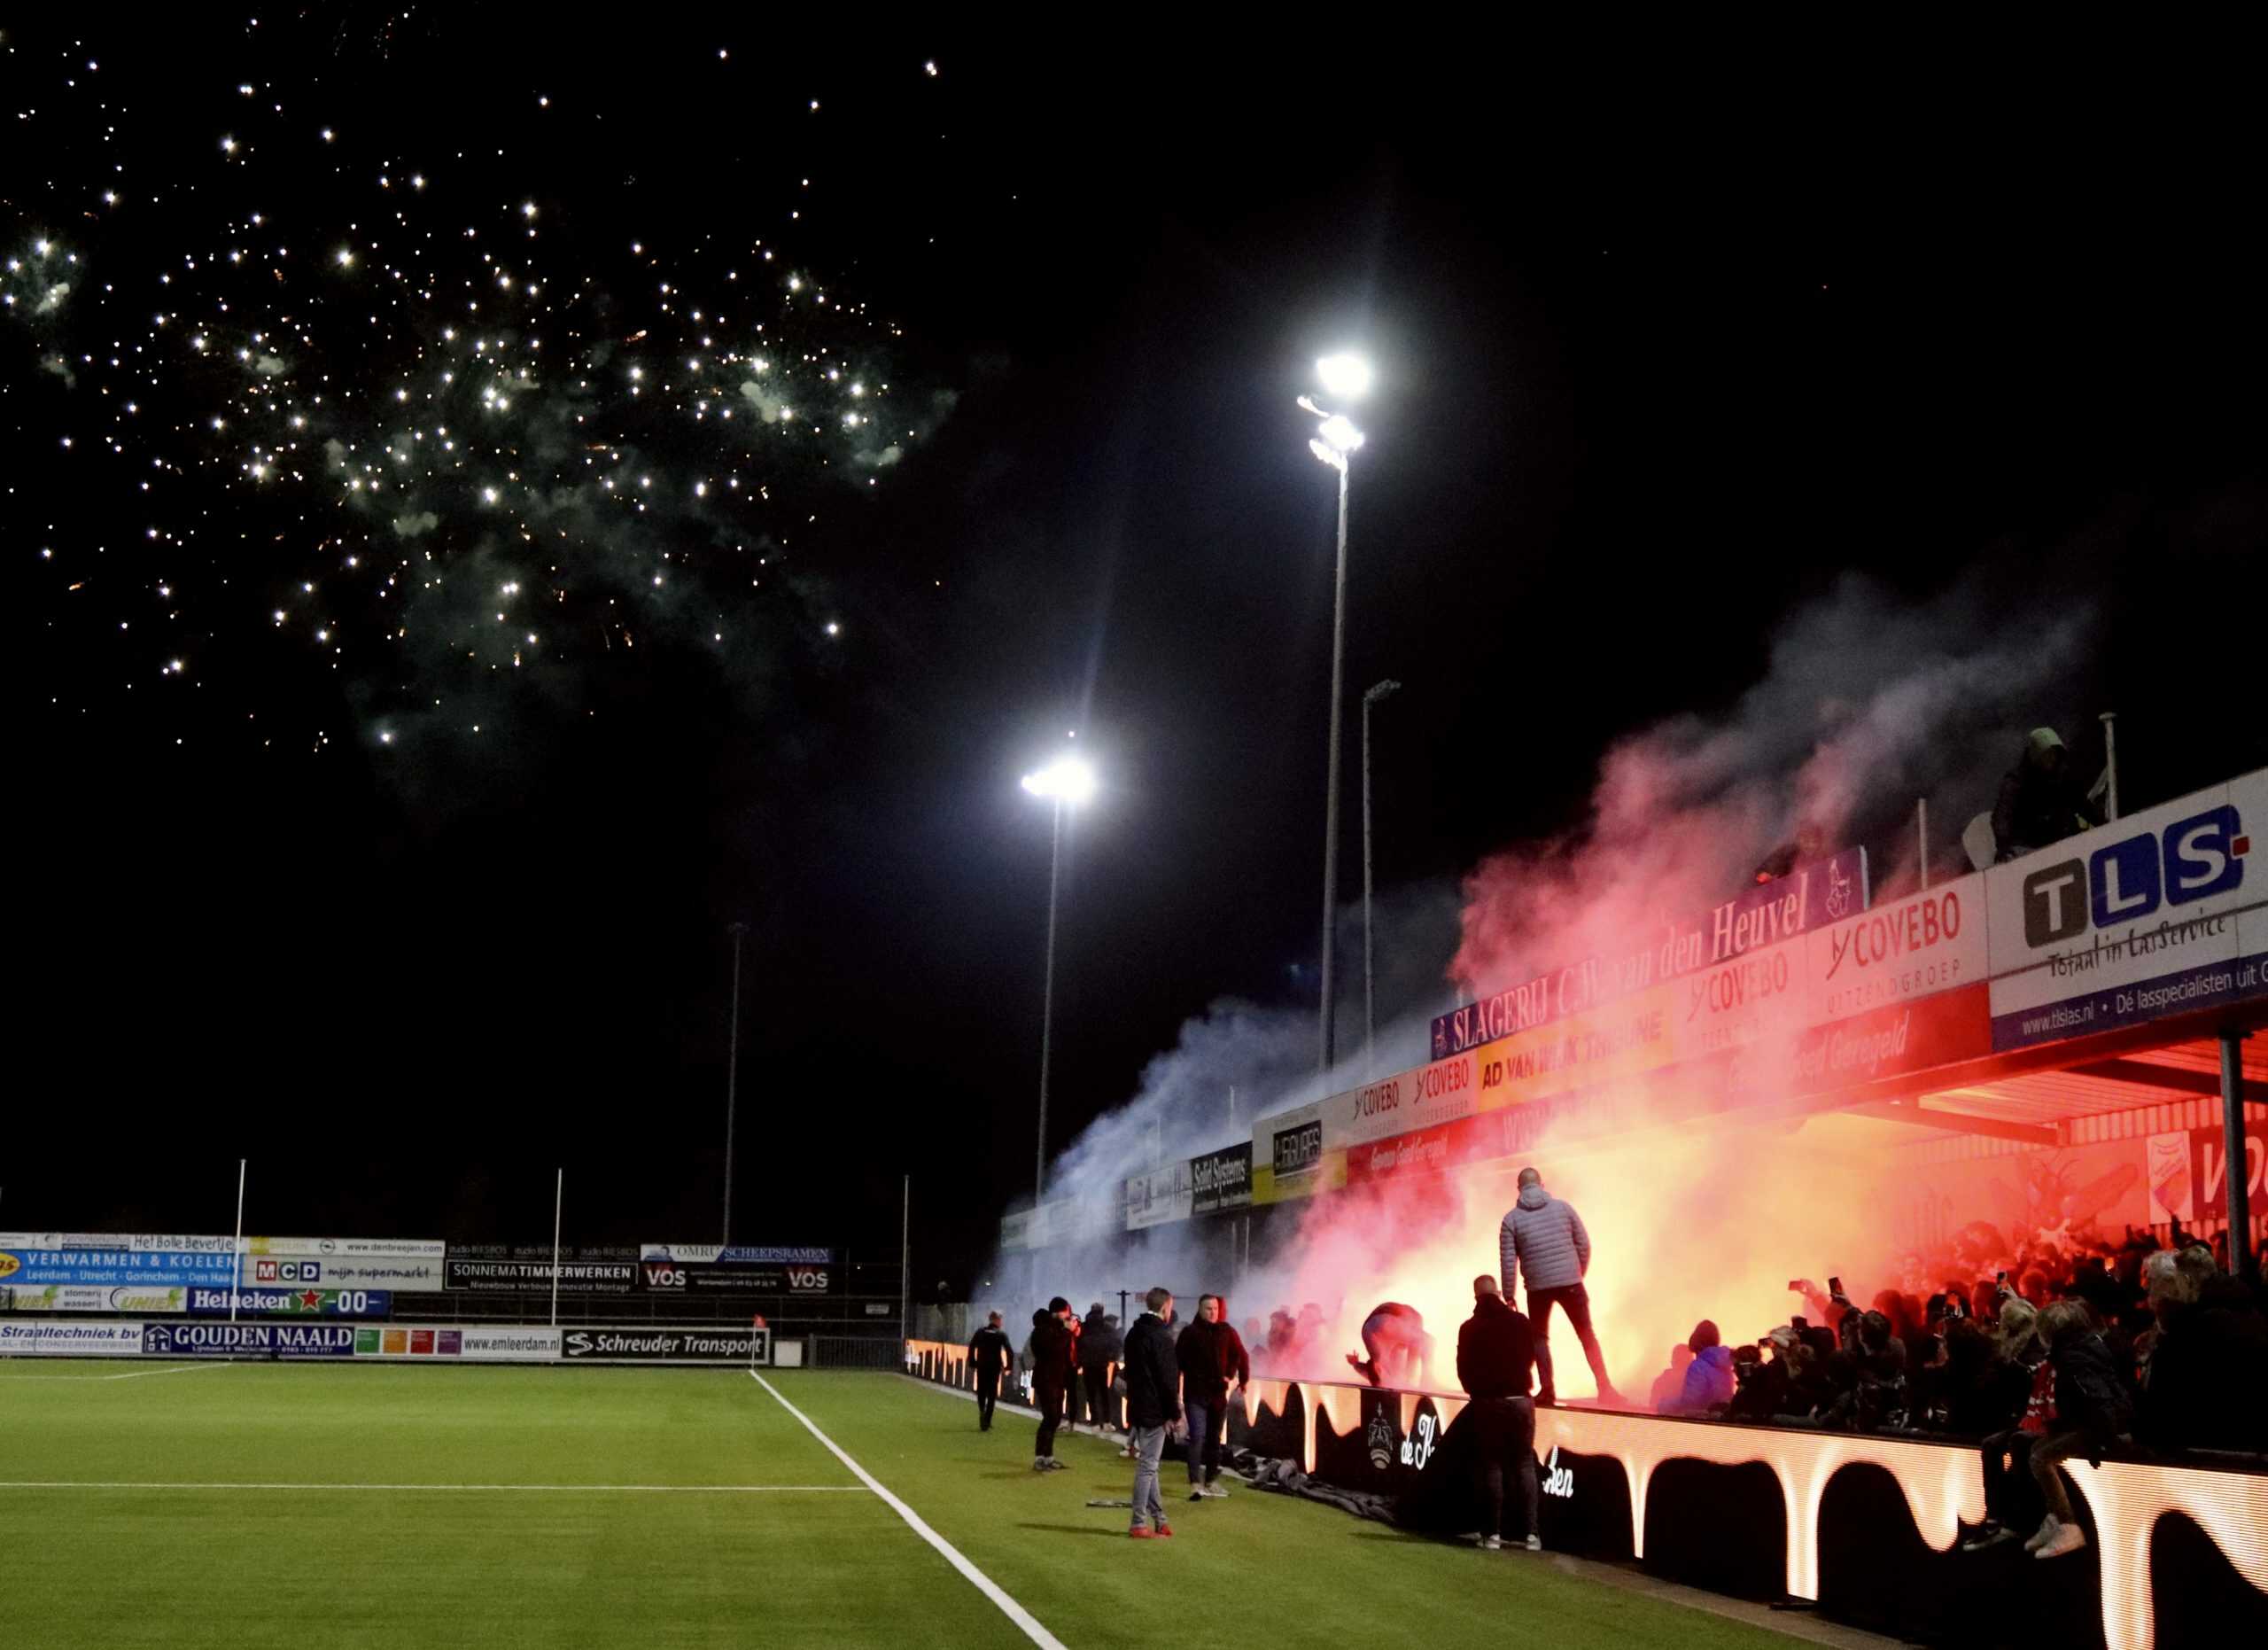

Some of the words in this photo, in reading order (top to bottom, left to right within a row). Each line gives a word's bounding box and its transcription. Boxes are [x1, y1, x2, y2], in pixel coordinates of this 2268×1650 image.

[2032, 823, 2227, 932] TLS
[1855, 891, 1961, 968] COVEBO
[1454, 977, 1550, 1051] SLAGERIJ
[1660, 925, 1701, 977] den
[1711, 872, 1808, 962] Heuvel
[1709, 951, 1789, 1013] COVEBO
[2023, 1001, 2093, 1036] www.tlslas.nl
[2117, 990, 2133, 1015] Dé
[2137, 970, 2233, 1013] lasspecialisten
[2237, 965, 2256, 986] uit
[1426, 1059, 1469, 1097] COVEBO
[1482, 1062, 1503, 1091] AD
[1506, 1051, 1534, 1080] VAN
[1363, 1081, 1399, 1117] COVEBO
[27, 1253, 141, 1266] VERWARMEN
[150, 1255, 160, 1267] &
[169, 1256, 237, 1269] KOELEN
[725, 1247, 828, 1258] SCHEEPSRAMEN
[27, 1268, 71, 1280] Leerdam
[80, 1268, 116, 1281] Utrecht
[126, 1270, 179, 1283] Gorinchem
[189, 1272, 206, 1282] Den
[258, 1263, 319, 1280] MCD
[328, 1267, 353, 1280] mijn
[358, 1266, 429, 1279] supermarkt
[454, 1265, 517, 1276] SONNEMA
[519, 1265, 631, 1279] TIMMERWERKEN
[647, 1269, 687, 1286] VOS
[788, 1272, 828, 1288] VOS
[64, 1289, 102, 1299] stomerij
[194, 1290, 291, 1309] Heineken
[63, 1300, 102, 1309] wasserij
[1, 1326, 114, 1339] Straaltechniek
[121, 1329, 141, 1339] bv
[175, 1327, 269, 1345] GOUDEN
[276, 1328, 353, 1347] NAALD
[464, 1336, 560, 1350] www.emleerdam.nl
[596, 1335, 680, 1351] Schreuder
[684, 1336, 762, 1355] Transport
[1401, 1430, 1414, 1466] de
